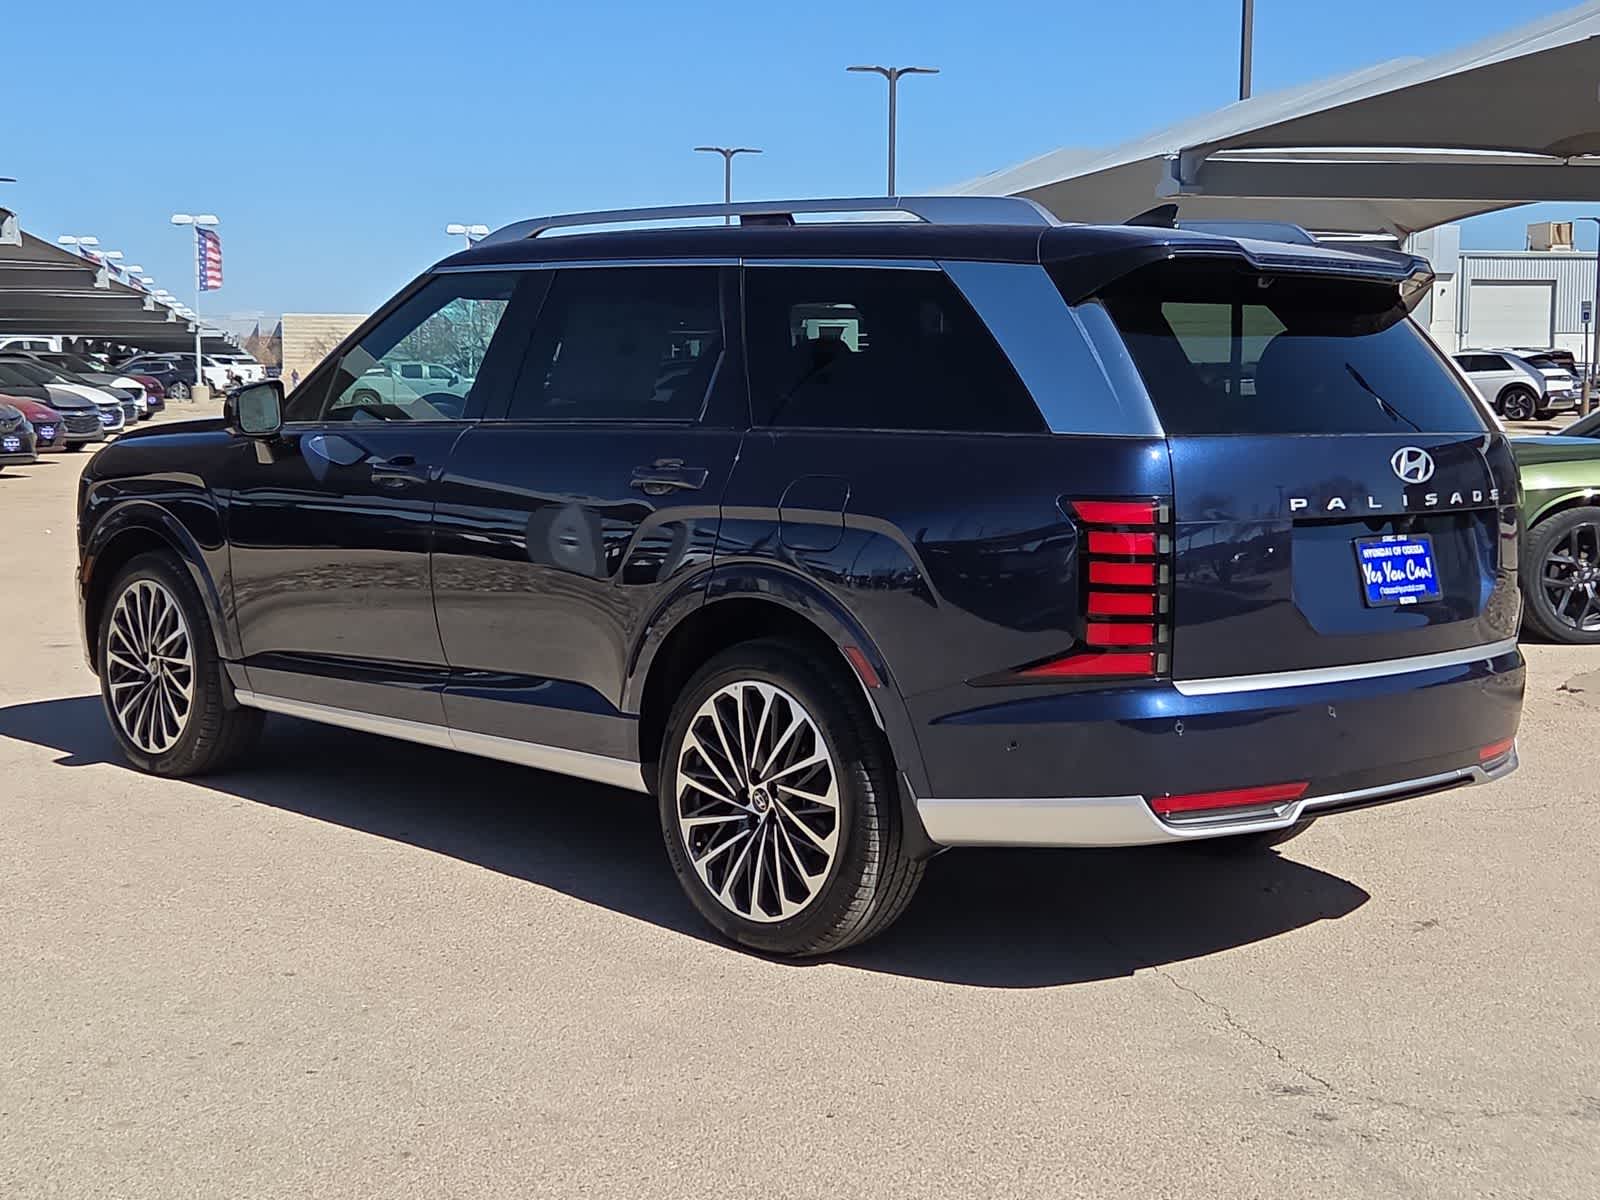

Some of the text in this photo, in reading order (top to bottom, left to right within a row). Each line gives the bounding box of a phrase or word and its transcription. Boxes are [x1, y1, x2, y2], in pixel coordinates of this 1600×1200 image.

[1289, 488, 1500, 512] PALISADE
[1362, 556, 1433, 585] Yes You Can!
